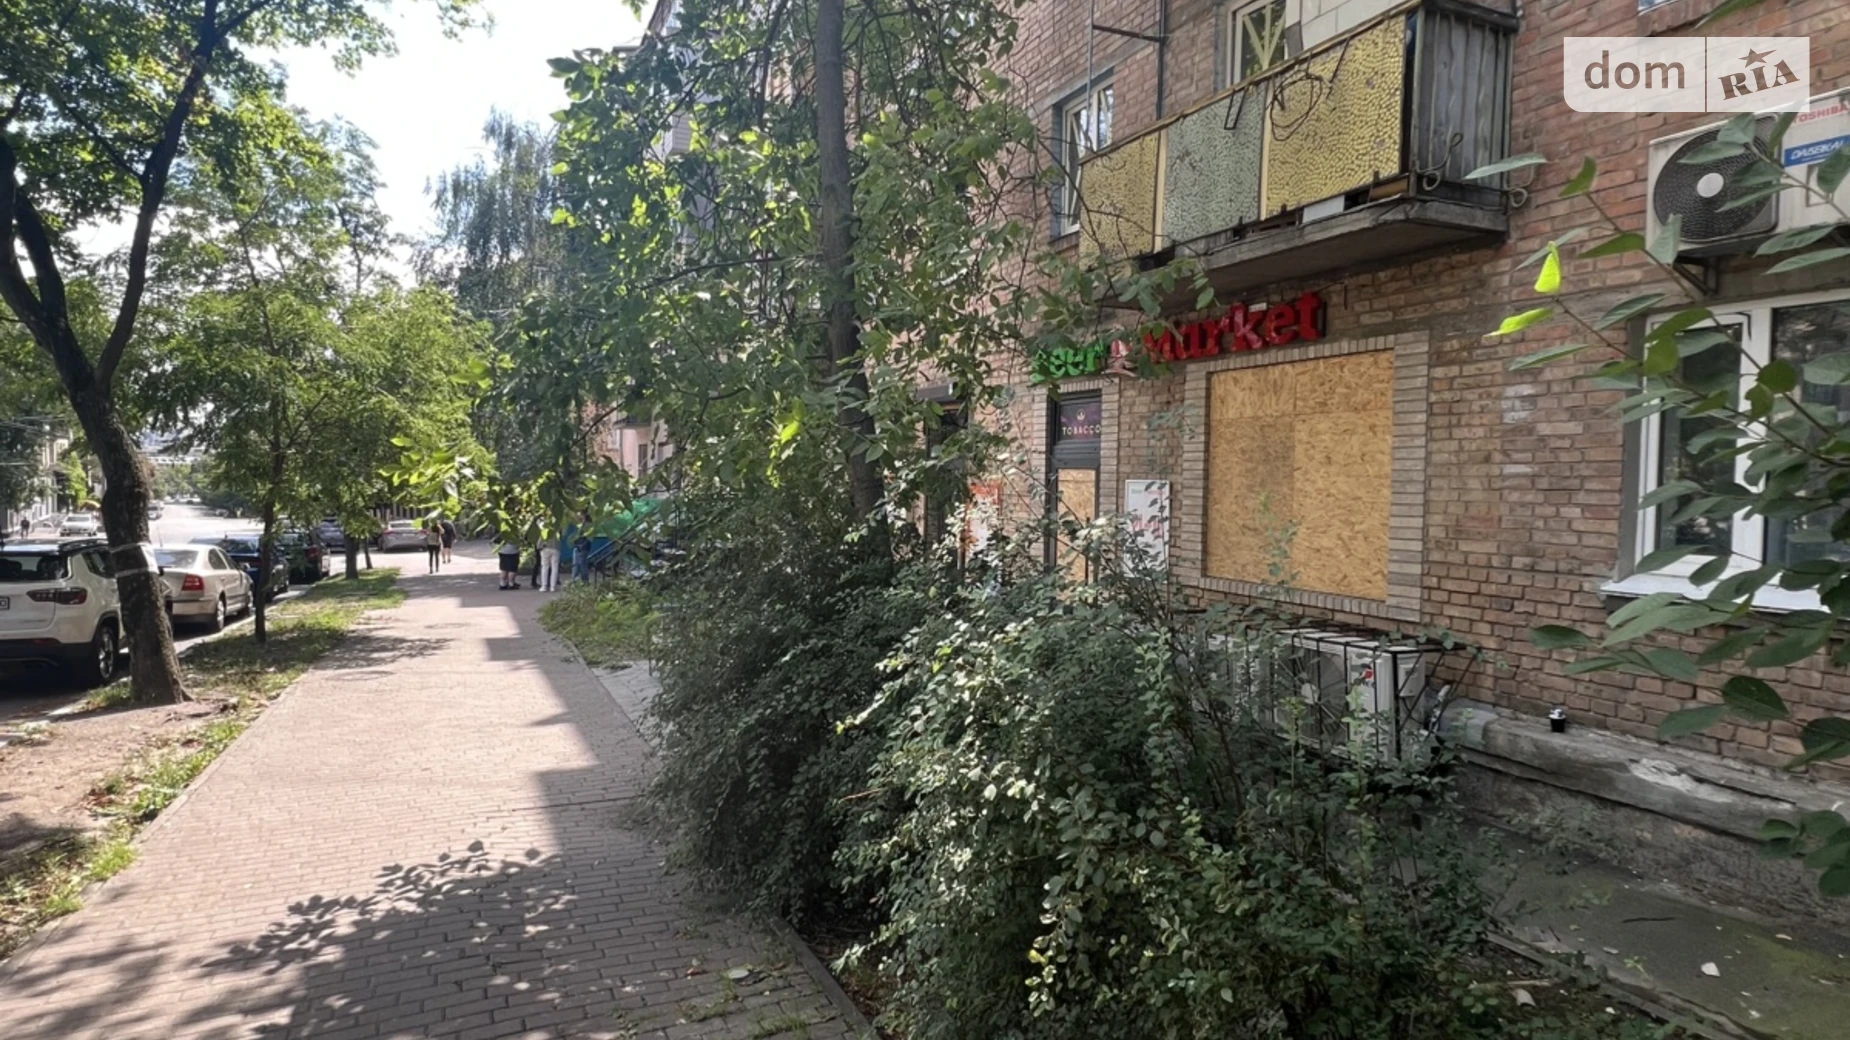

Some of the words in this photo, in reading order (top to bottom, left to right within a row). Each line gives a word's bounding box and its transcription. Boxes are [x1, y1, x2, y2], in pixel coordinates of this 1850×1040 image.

[1794, 104, 1848, 124] OSHIBA
[1142, 290, 1322, 364] Market
[1062, 424, 1102, 436] TOBACCO
